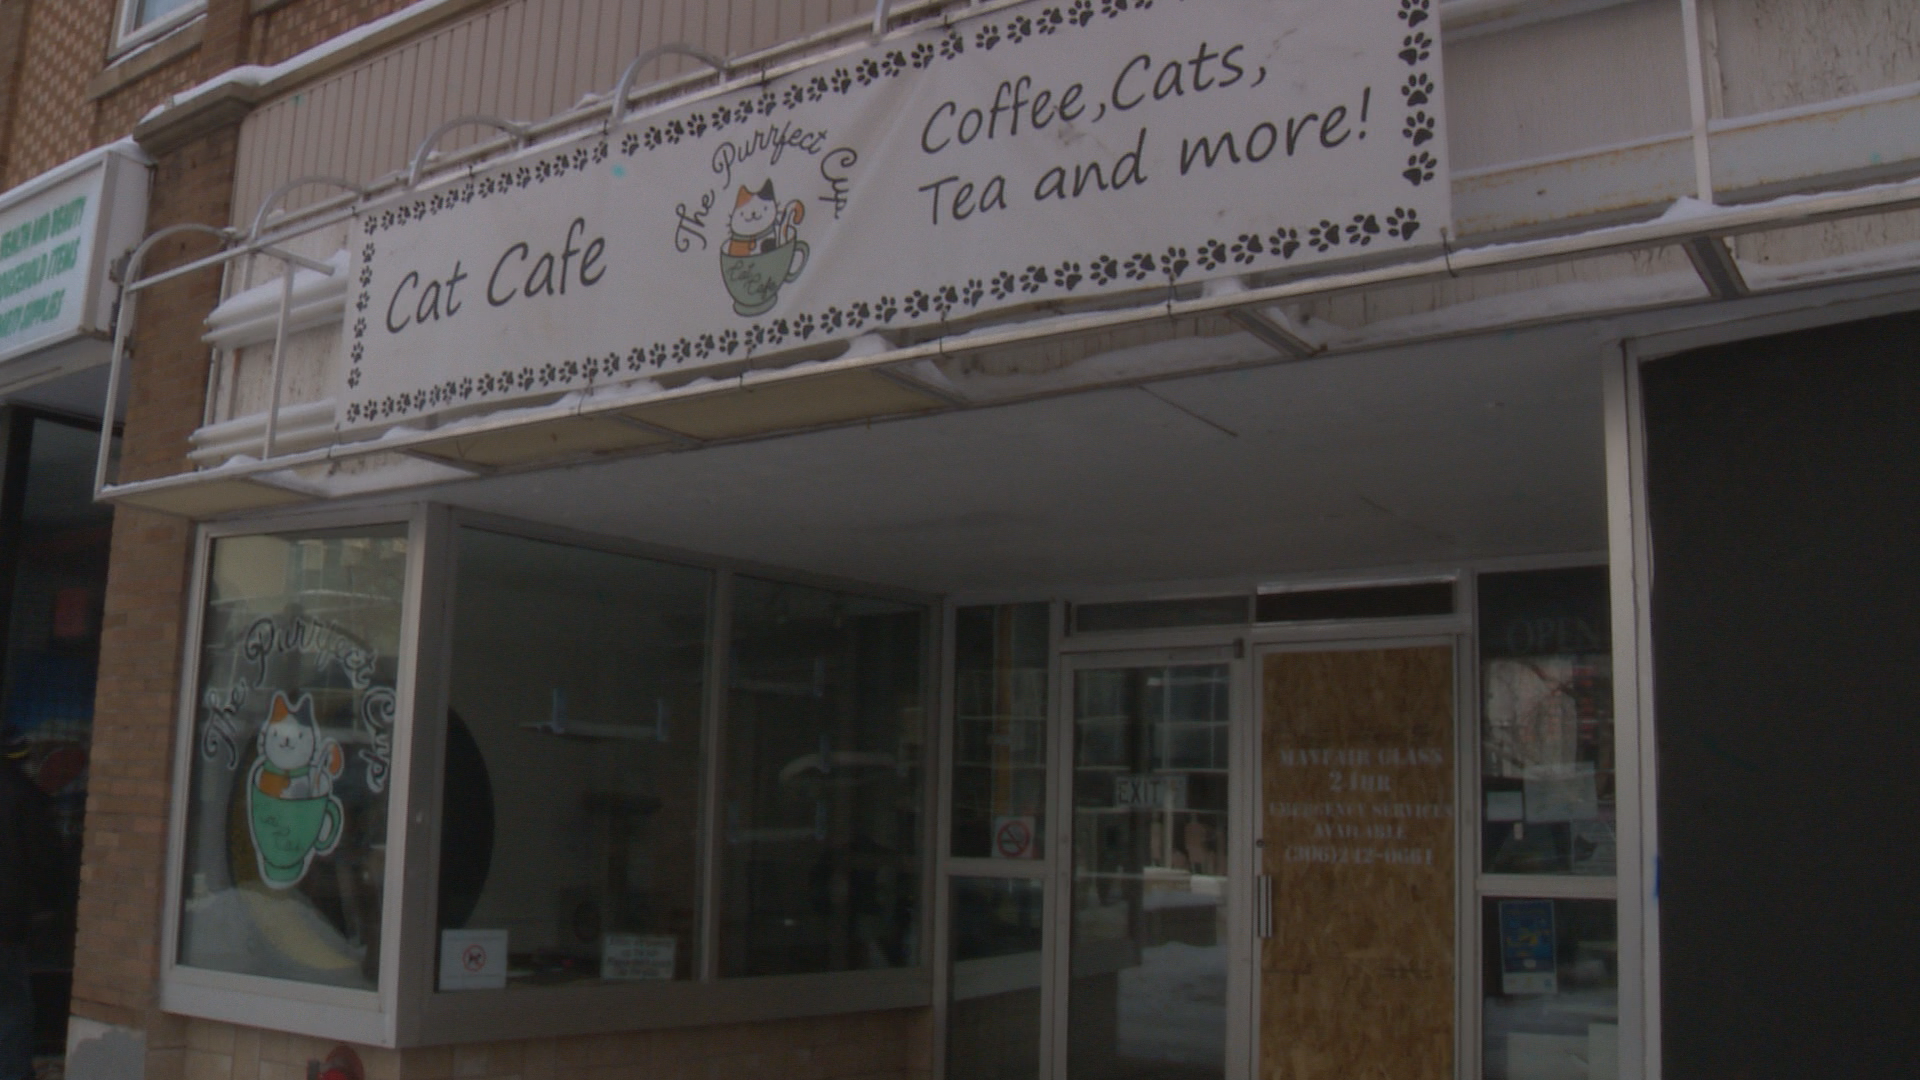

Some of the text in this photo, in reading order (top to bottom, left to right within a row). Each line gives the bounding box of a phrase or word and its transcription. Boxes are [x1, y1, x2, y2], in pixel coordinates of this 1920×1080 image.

[674, 121, 858, 253] The Purrfect Cup
[918, 86, 1372, 227] Tea and more!
[385, 217, 608, 335] Cat Cafe
[1507, 618, 1603, 654] OPEN
[202, 616, 396, 793] The Purrfect Cup
[1378, 746, 1444, 766] GLASS
[1117, 780, 1160, 804] EXIT
